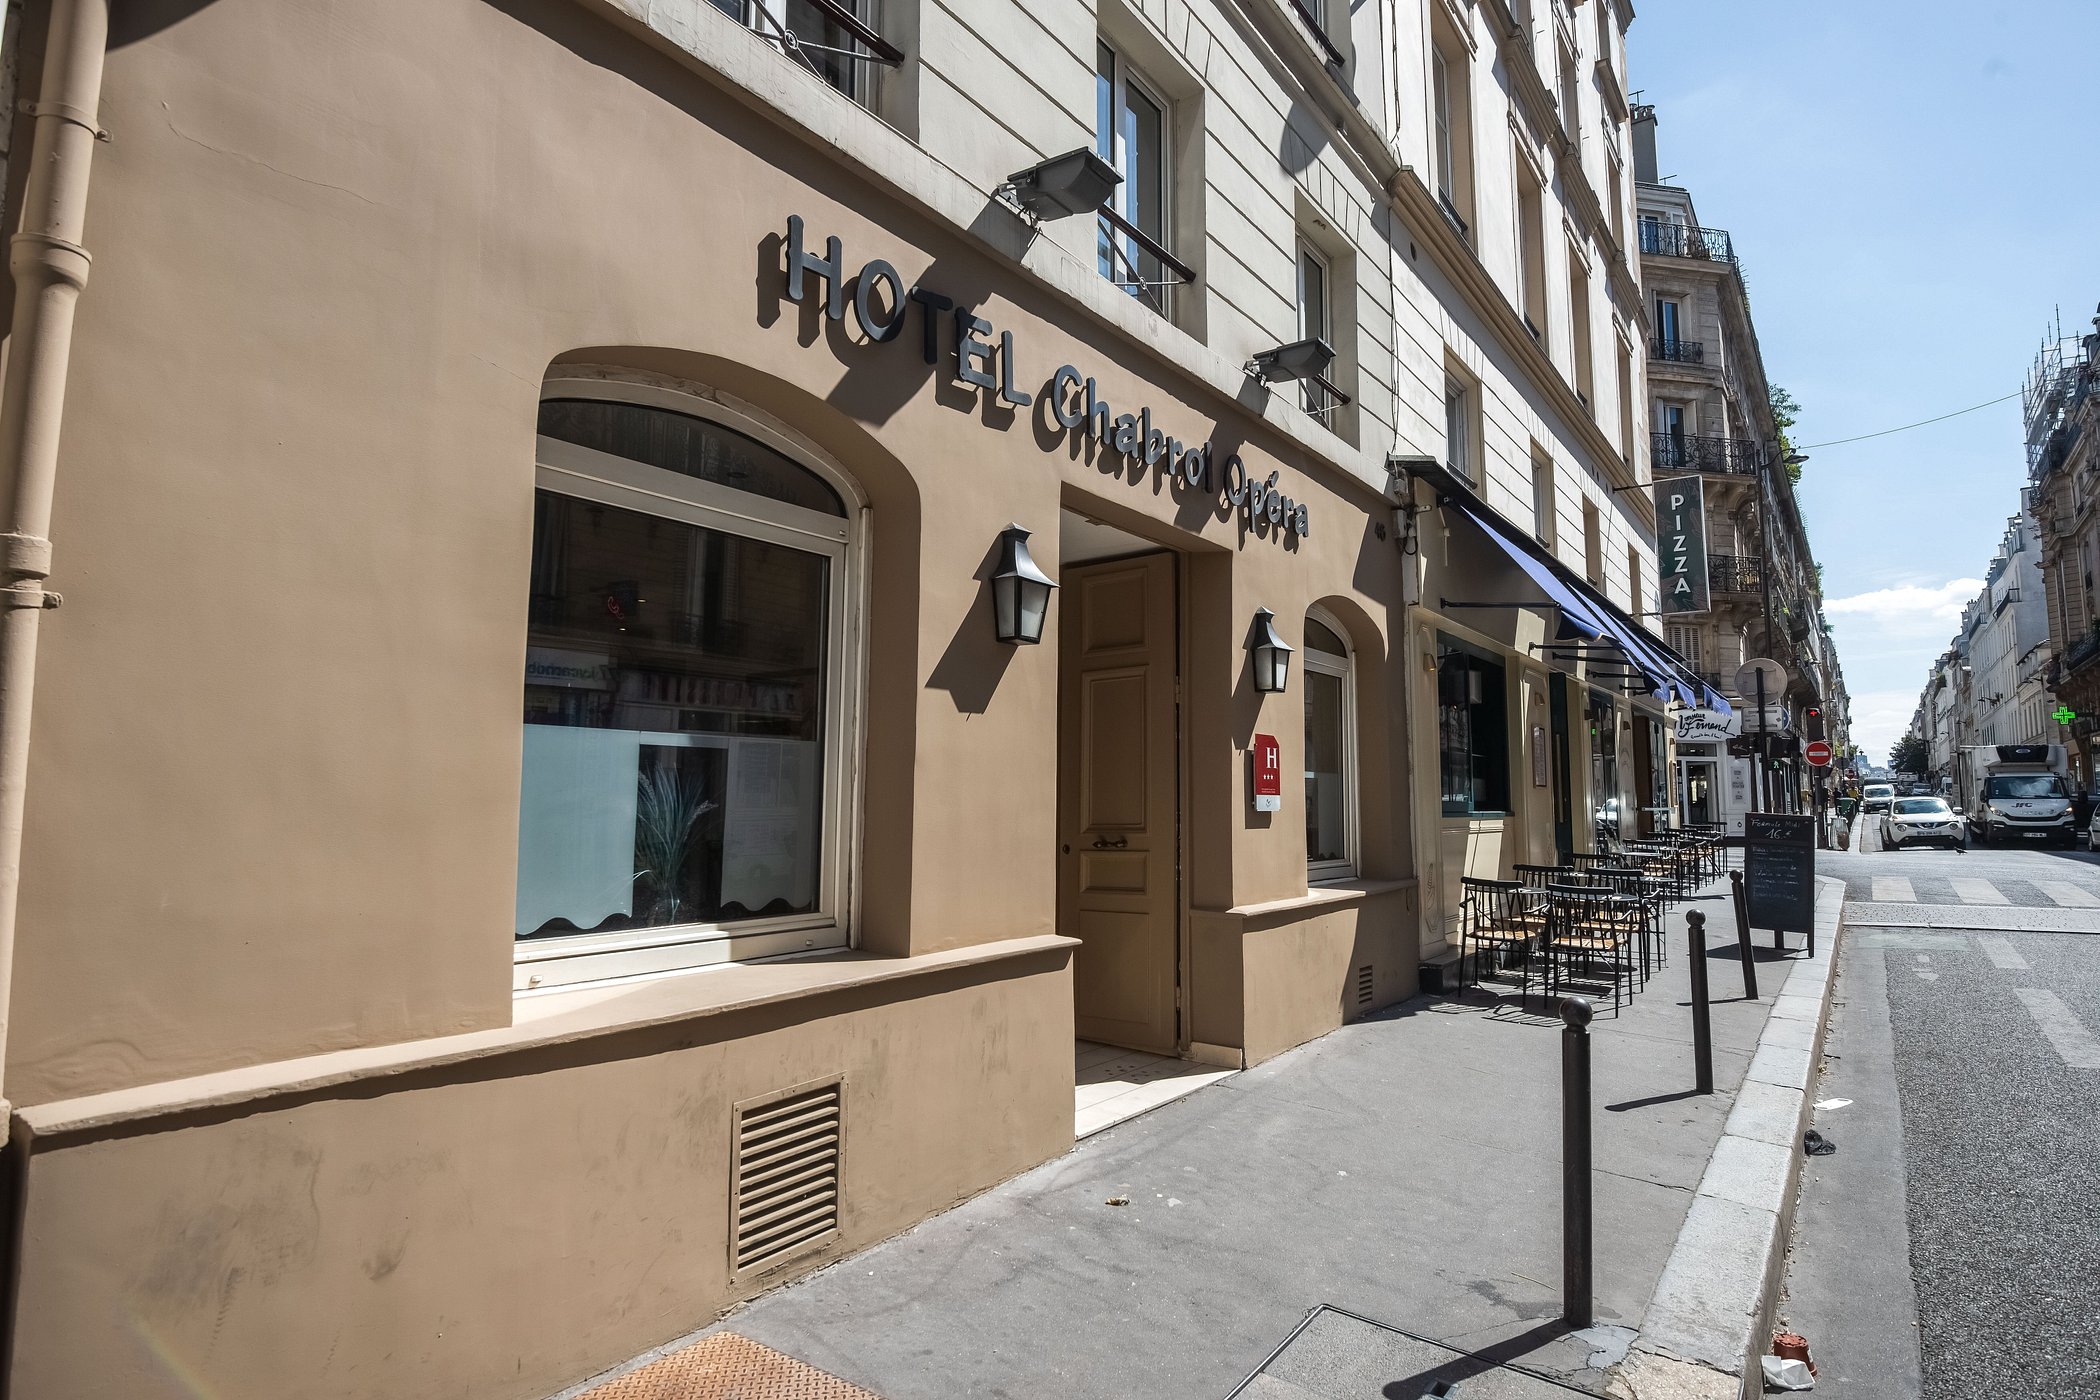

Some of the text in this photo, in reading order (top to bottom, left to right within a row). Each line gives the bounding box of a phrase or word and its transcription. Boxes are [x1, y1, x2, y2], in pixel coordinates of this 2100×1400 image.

[785, 214, 1309, 538] HOTEL Chabrol Opéra
[1670, 494, 1691, 595] PIZZA
[1266, 747, 1278, 769] H
